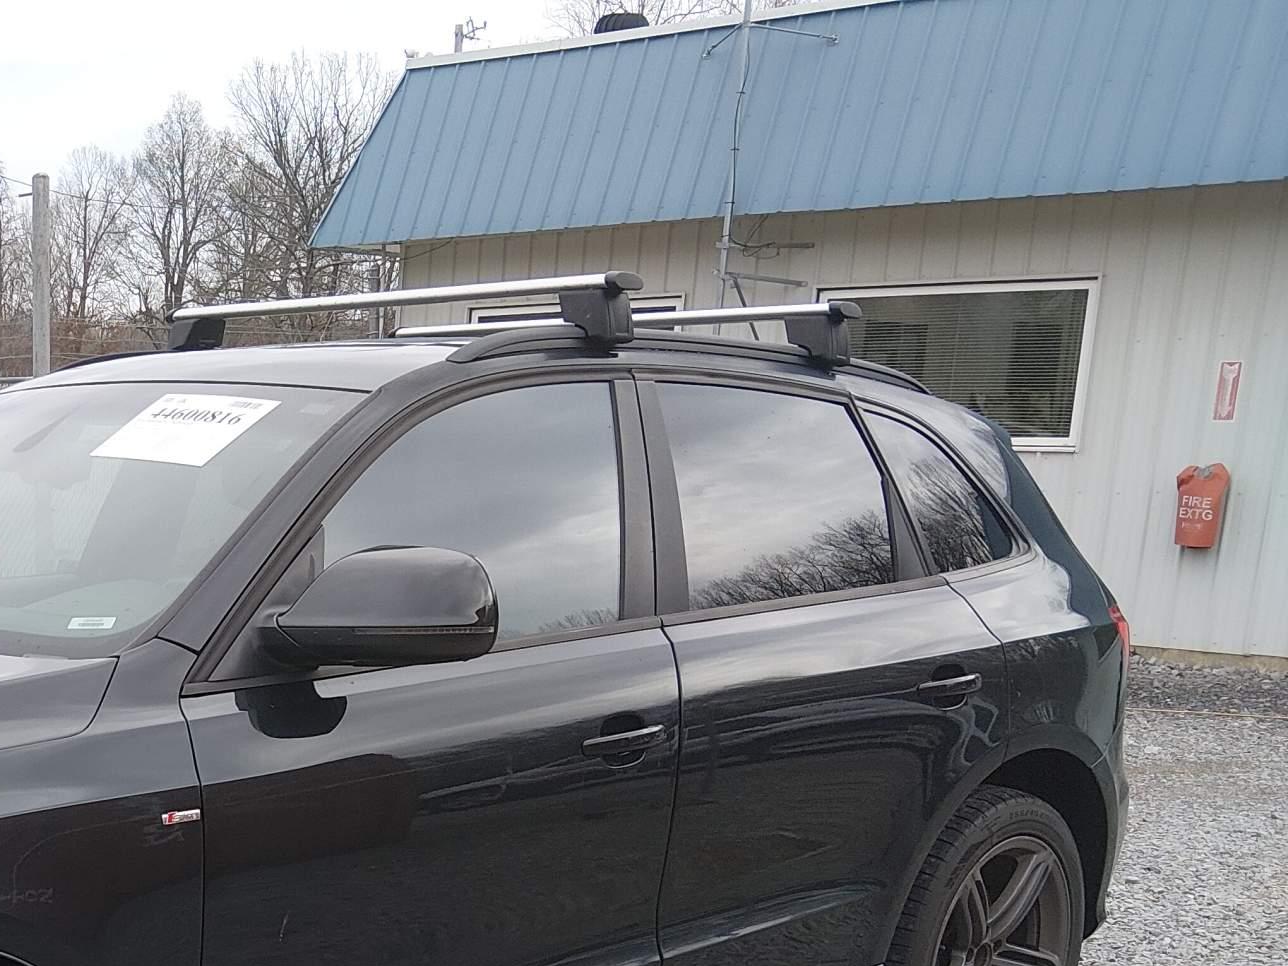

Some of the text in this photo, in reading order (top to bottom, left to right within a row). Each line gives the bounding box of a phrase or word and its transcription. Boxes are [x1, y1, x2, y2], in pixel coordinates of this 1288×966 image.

[151, 408, 244, 424] 44600816
[1182, 495, 1213, 509] FIRE
[1179, 507, 1213, 520] EXTG
